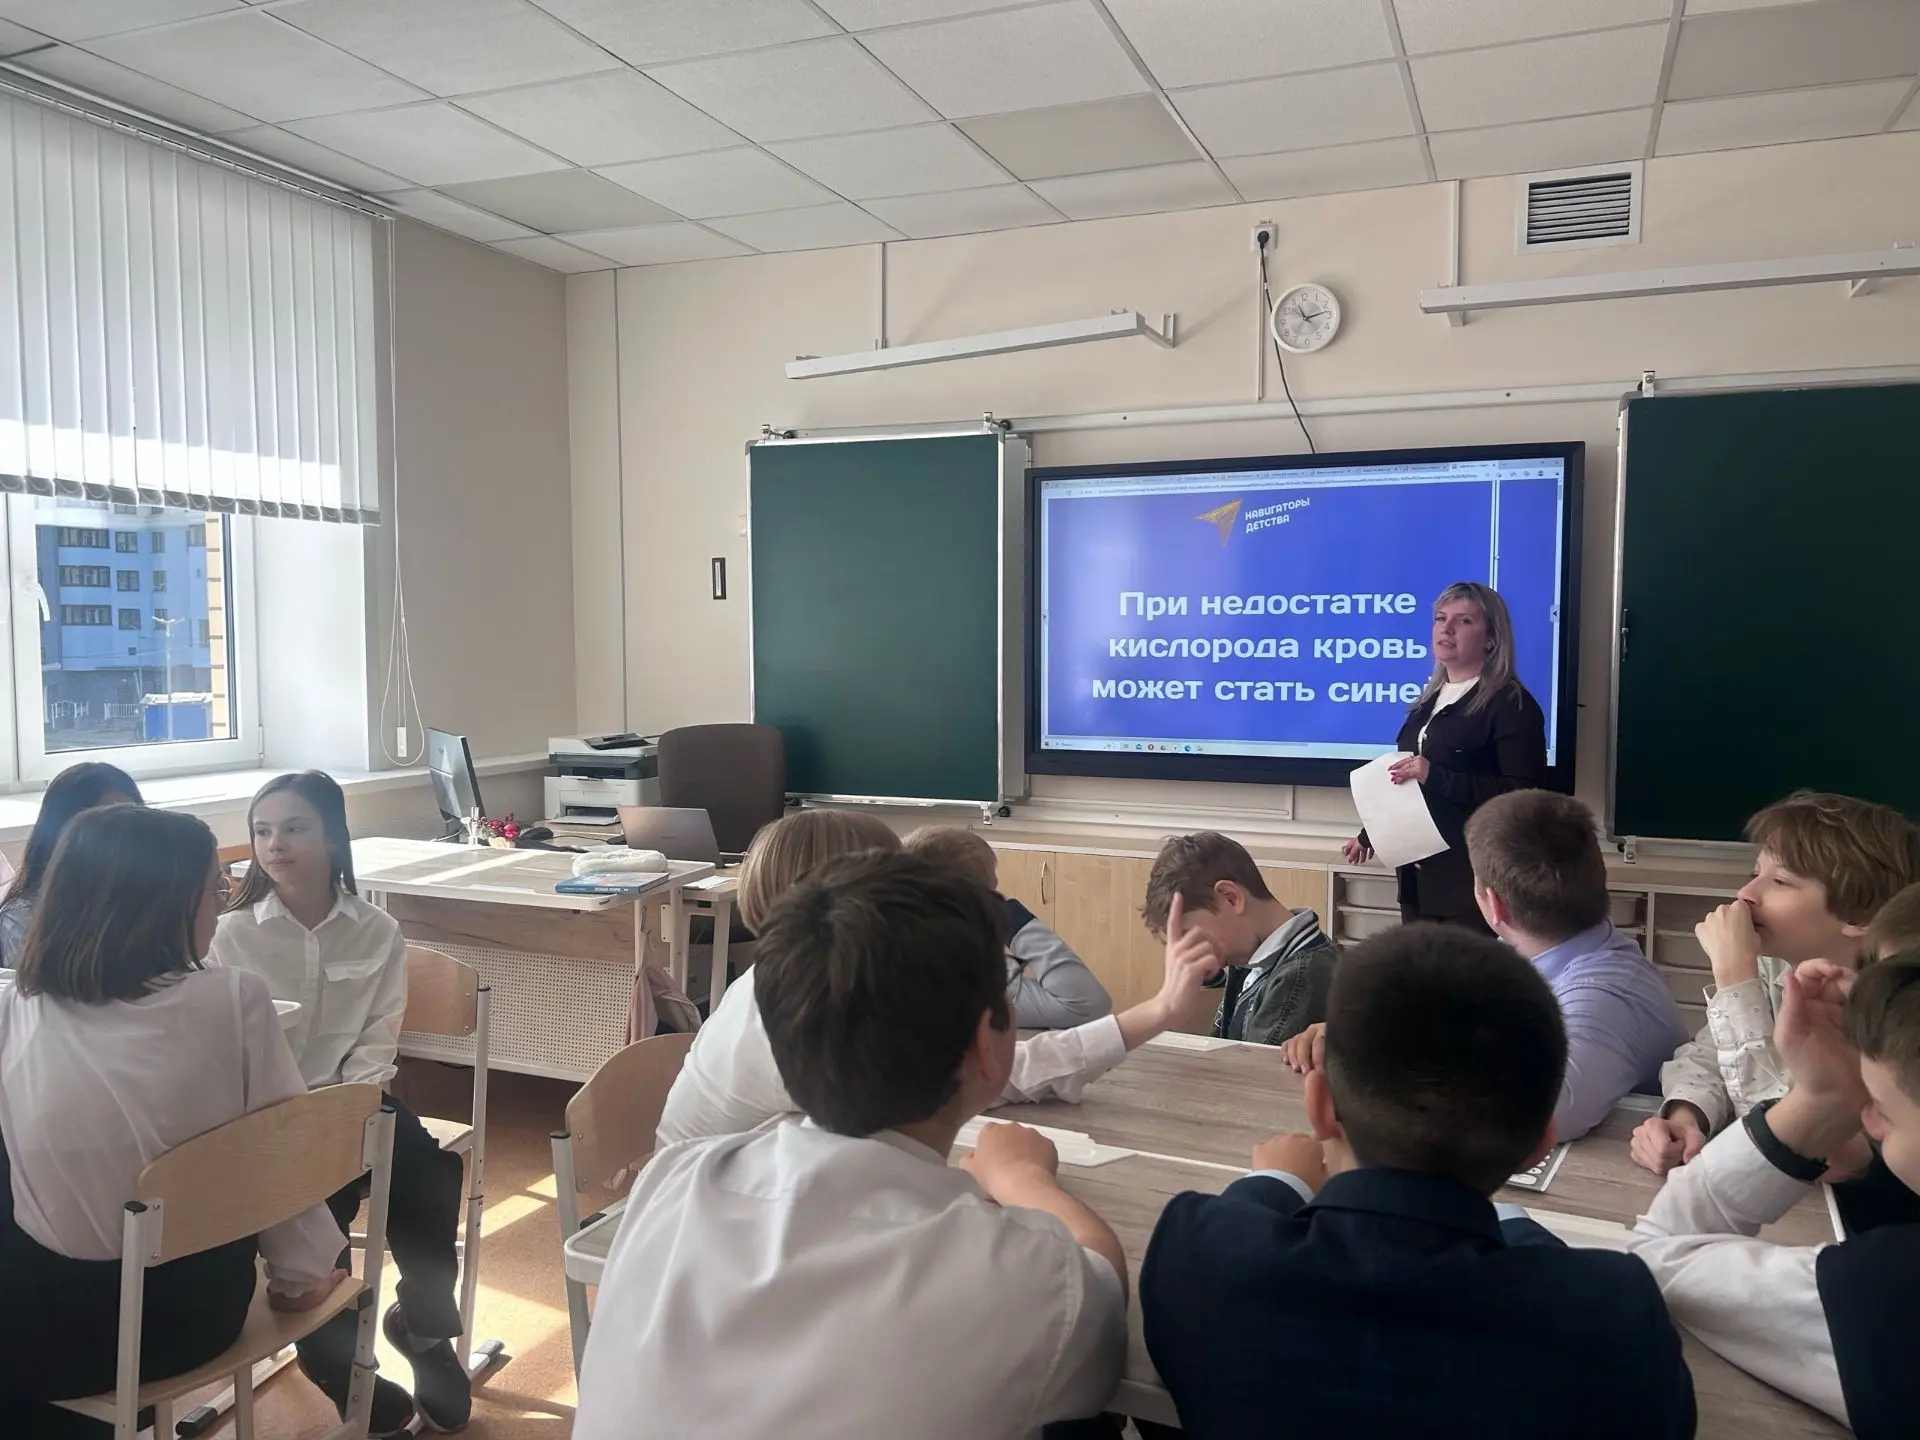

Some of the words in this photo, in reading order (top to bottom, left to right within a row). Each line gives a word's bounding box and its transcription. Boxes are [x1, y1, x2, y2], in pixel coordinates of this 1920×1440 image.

[1245, 497, 1311, 521] НАВИГАТОРЫ
[1246, 514, 1290, 534] ДЕТСТВА
[1120, 591, 1188, 621] При
[1201, 593, 1417, 616] недостатке
[1109, 638, 1299, 663] кислорода
[1313, 638, 1427, 664] кровь
[1092, 679, 1203, 700] может
[1214, 681, 1315, 702] стать
[1328, 676, 1432, 703] сине
